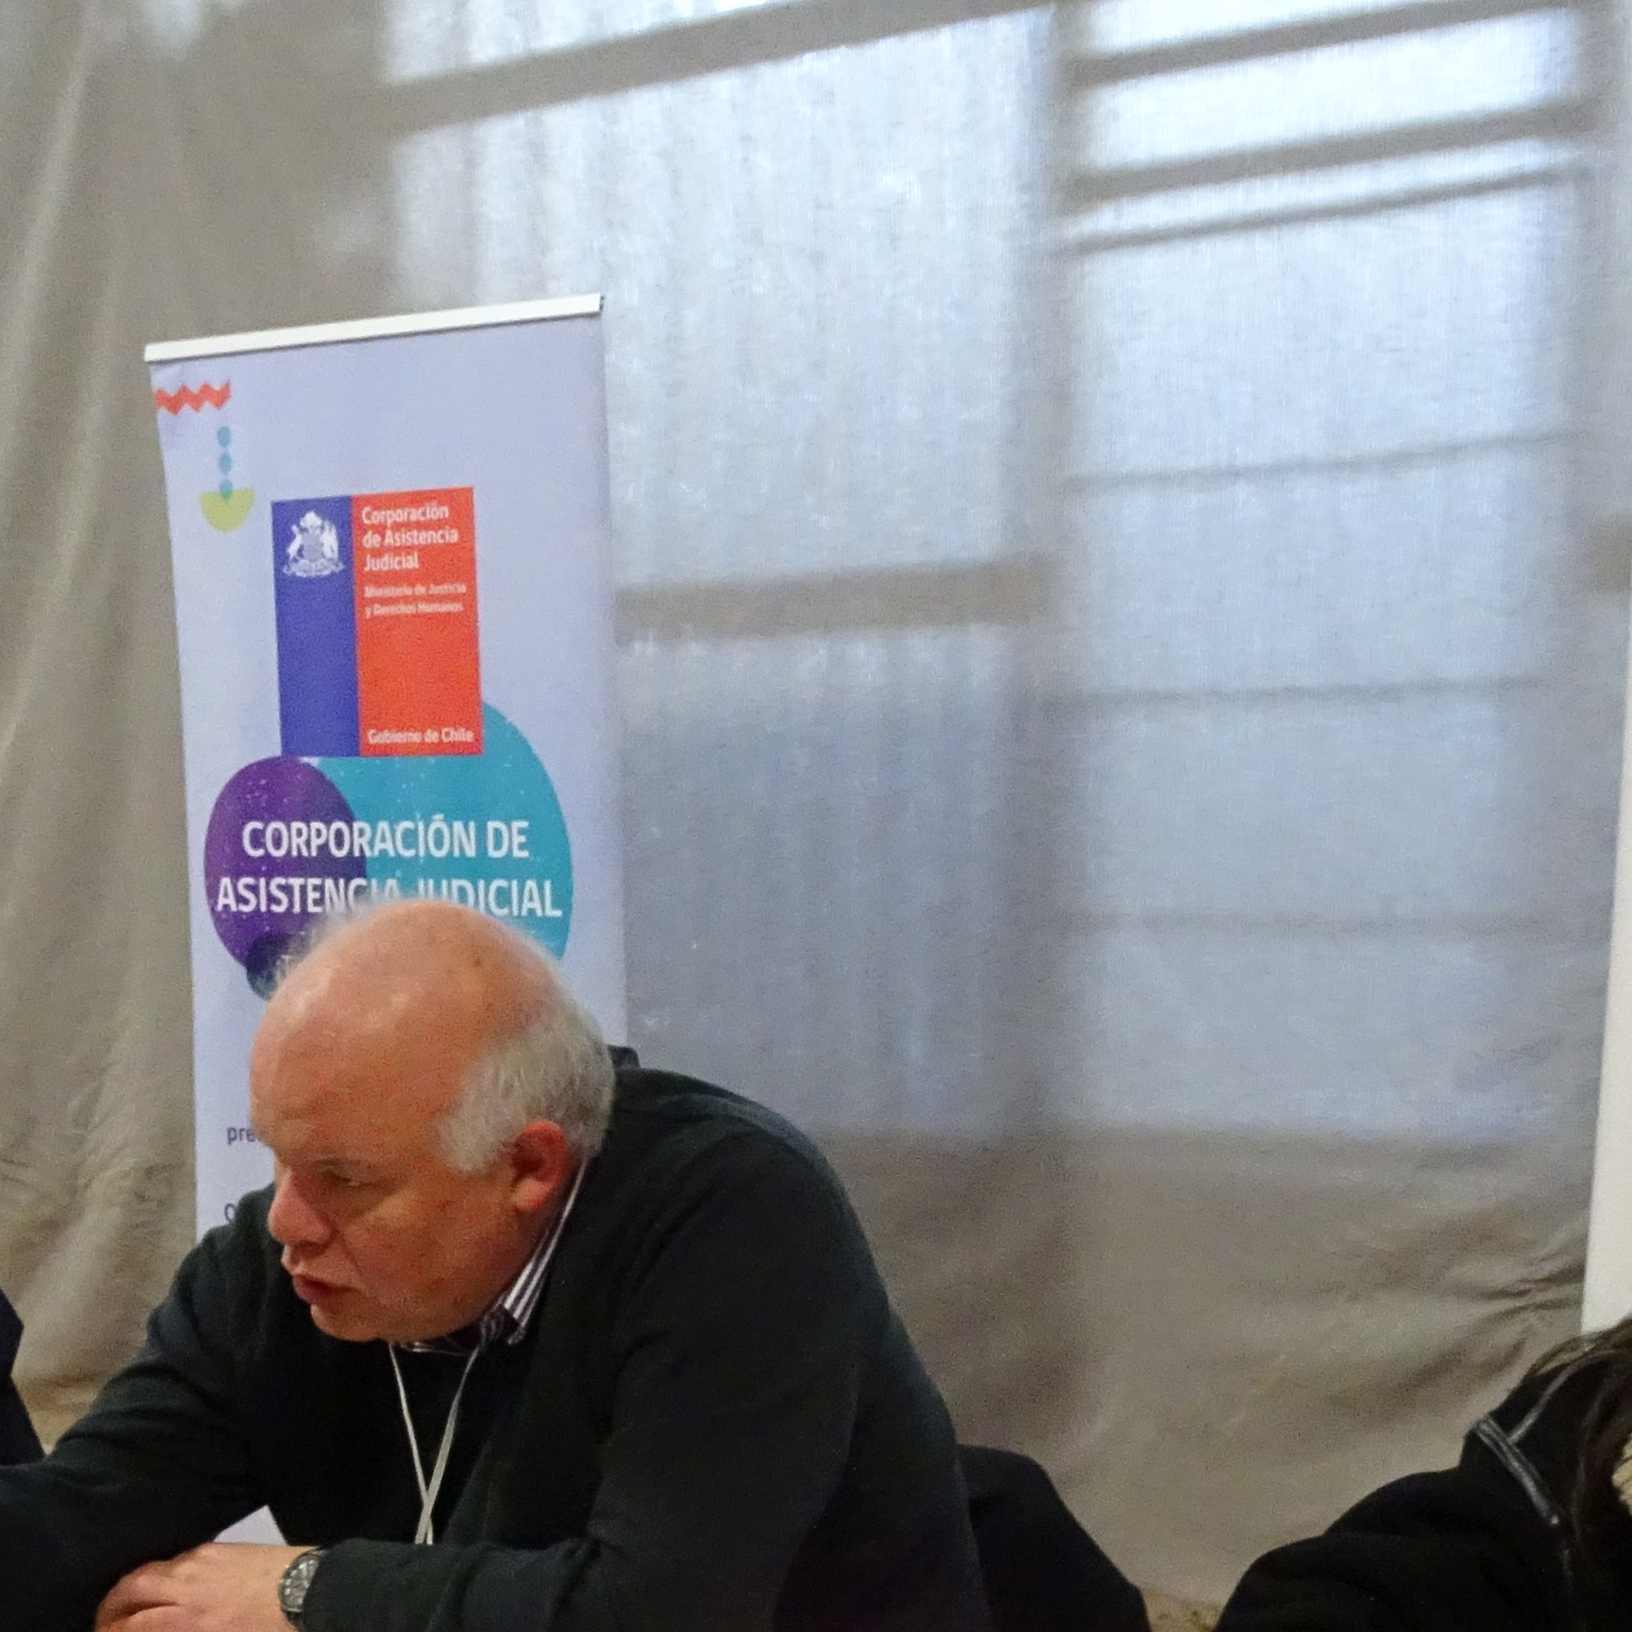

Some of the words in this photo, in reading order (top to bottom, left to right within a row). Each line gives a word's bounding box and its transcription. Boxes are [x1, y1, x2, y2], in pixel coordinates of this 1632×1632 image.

[361, 502, 449, 529] Corporación
[362, 530, 382, 549] de
[383, 527, 459, 547] Asistencia
[364, 551, 419, 572] Judicial
[368, 729, 422, 745] Gobierno
[424, 728, 440, 744] de
[441, 727, 475, 743] Chile
[242, 814, 476, 858] CORPORACIÓN
[486, 820, 529, 859] DE
